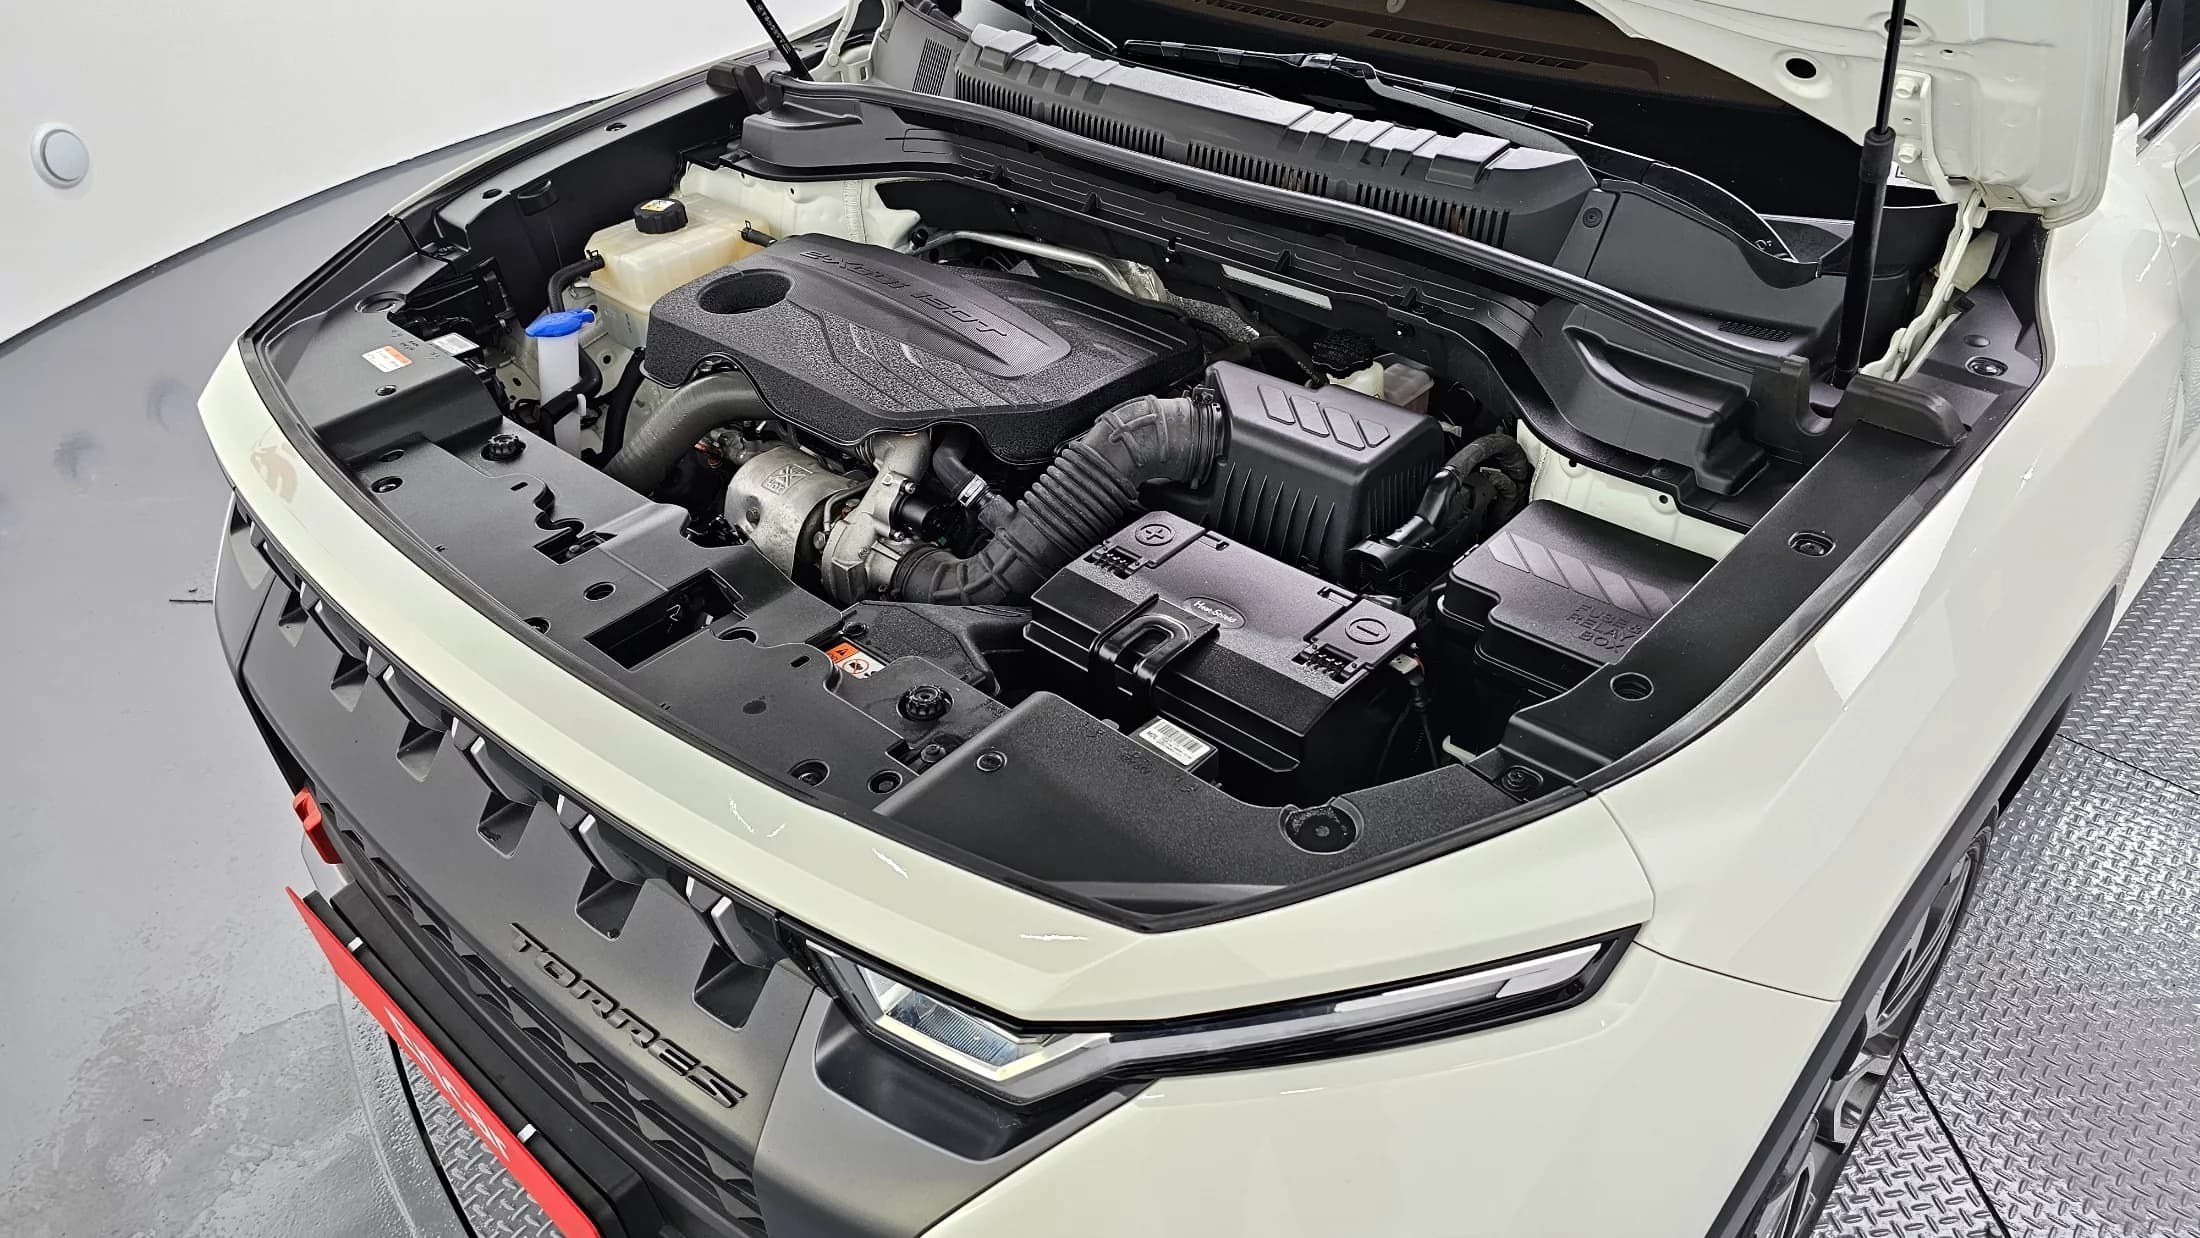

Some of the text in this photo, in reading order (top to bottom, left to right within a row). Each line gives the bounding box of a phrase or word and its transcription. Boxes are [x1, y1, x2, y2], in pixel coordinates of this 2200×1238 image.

[910, 294, 1007, 338] 150T
[1565, 613, 1635, 642] RELAY
[1578, 631, 1625, 653] BOX
[510, 922, 748, 1108] TORRES
